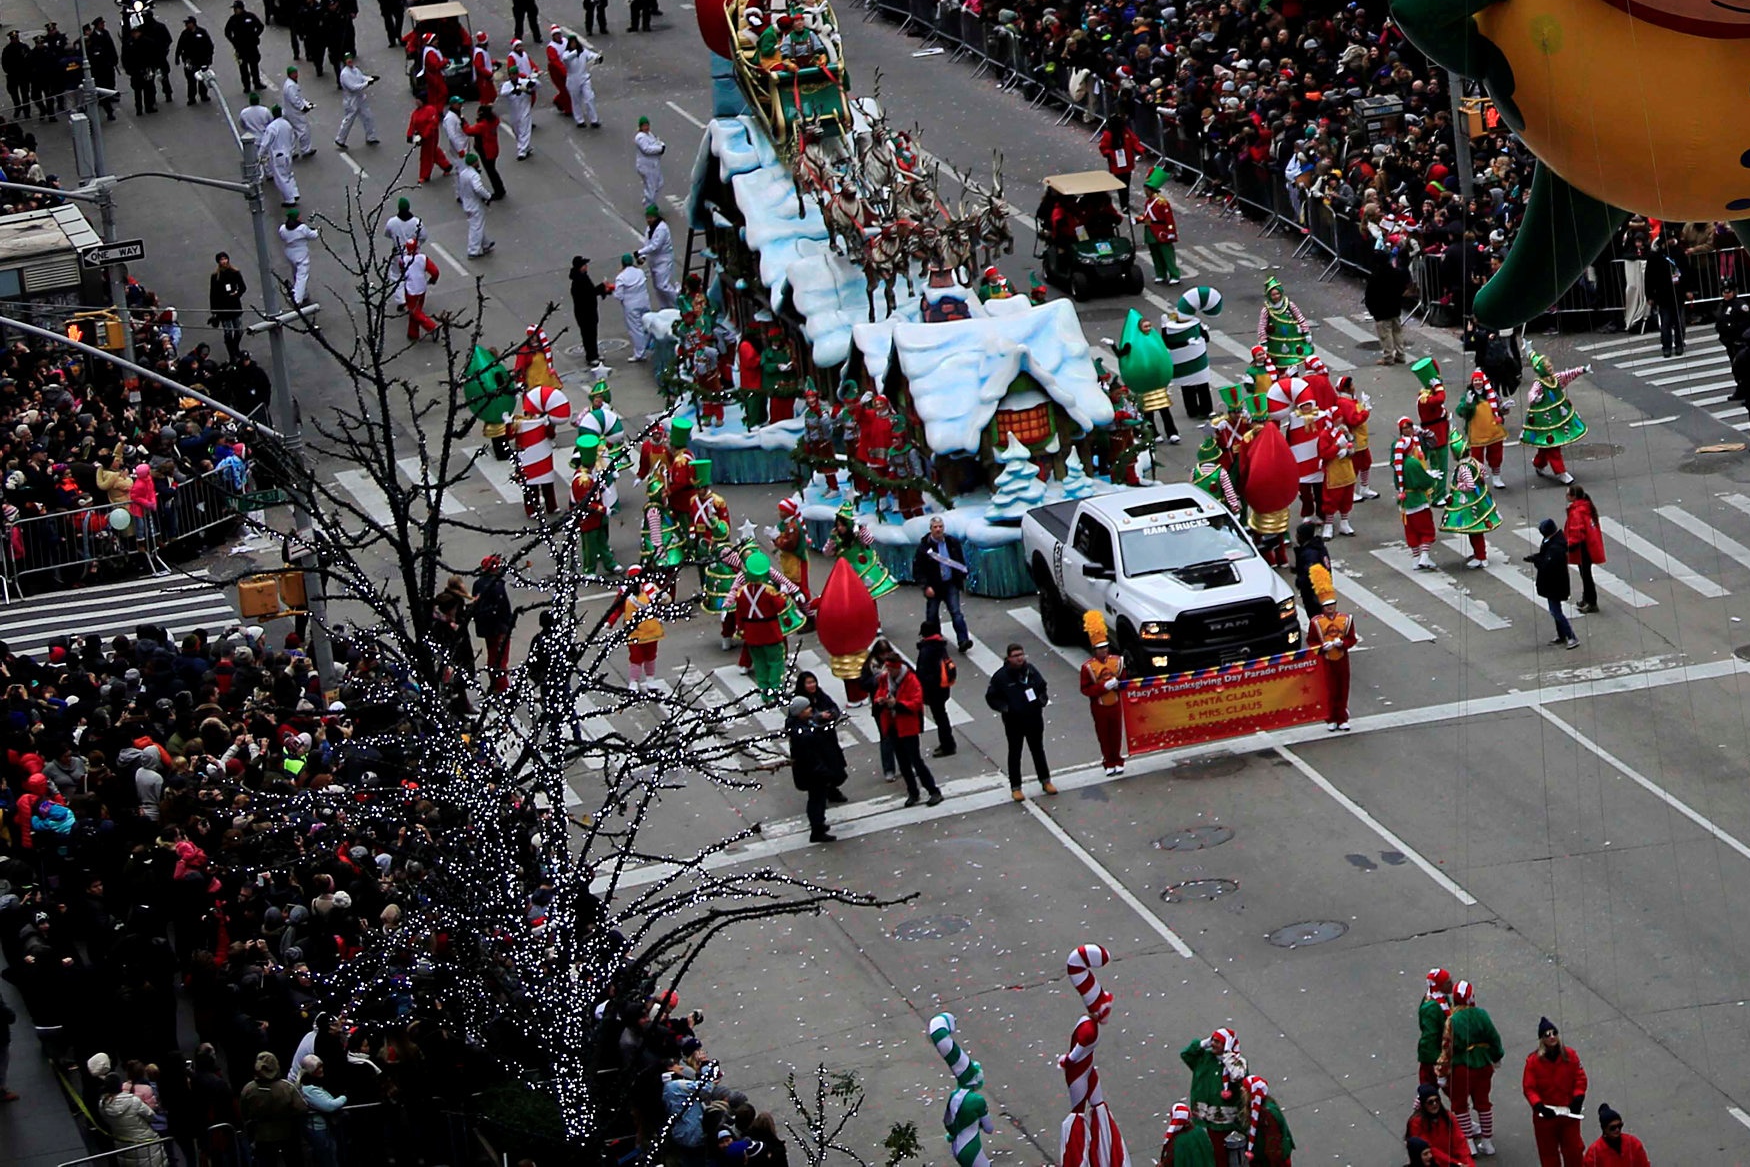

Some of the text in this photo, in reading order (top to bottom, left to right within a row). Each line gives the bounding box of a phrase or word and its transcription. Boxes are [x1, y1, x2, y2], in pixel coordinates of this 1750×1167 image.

[91, 246, 139, 261] ONE WAY
[1143, 518, 1211, 536] RAM TRUCKS
[1209, 619, 1249, 631] RAM
[1127, 658, 1317, 699] Macy's Thanksgiving Day Parade Presents
[1185, 688, 1263, 709] SANTA CLAUS
[1188, 701, 1263, 721] & MRS. CLAUS
